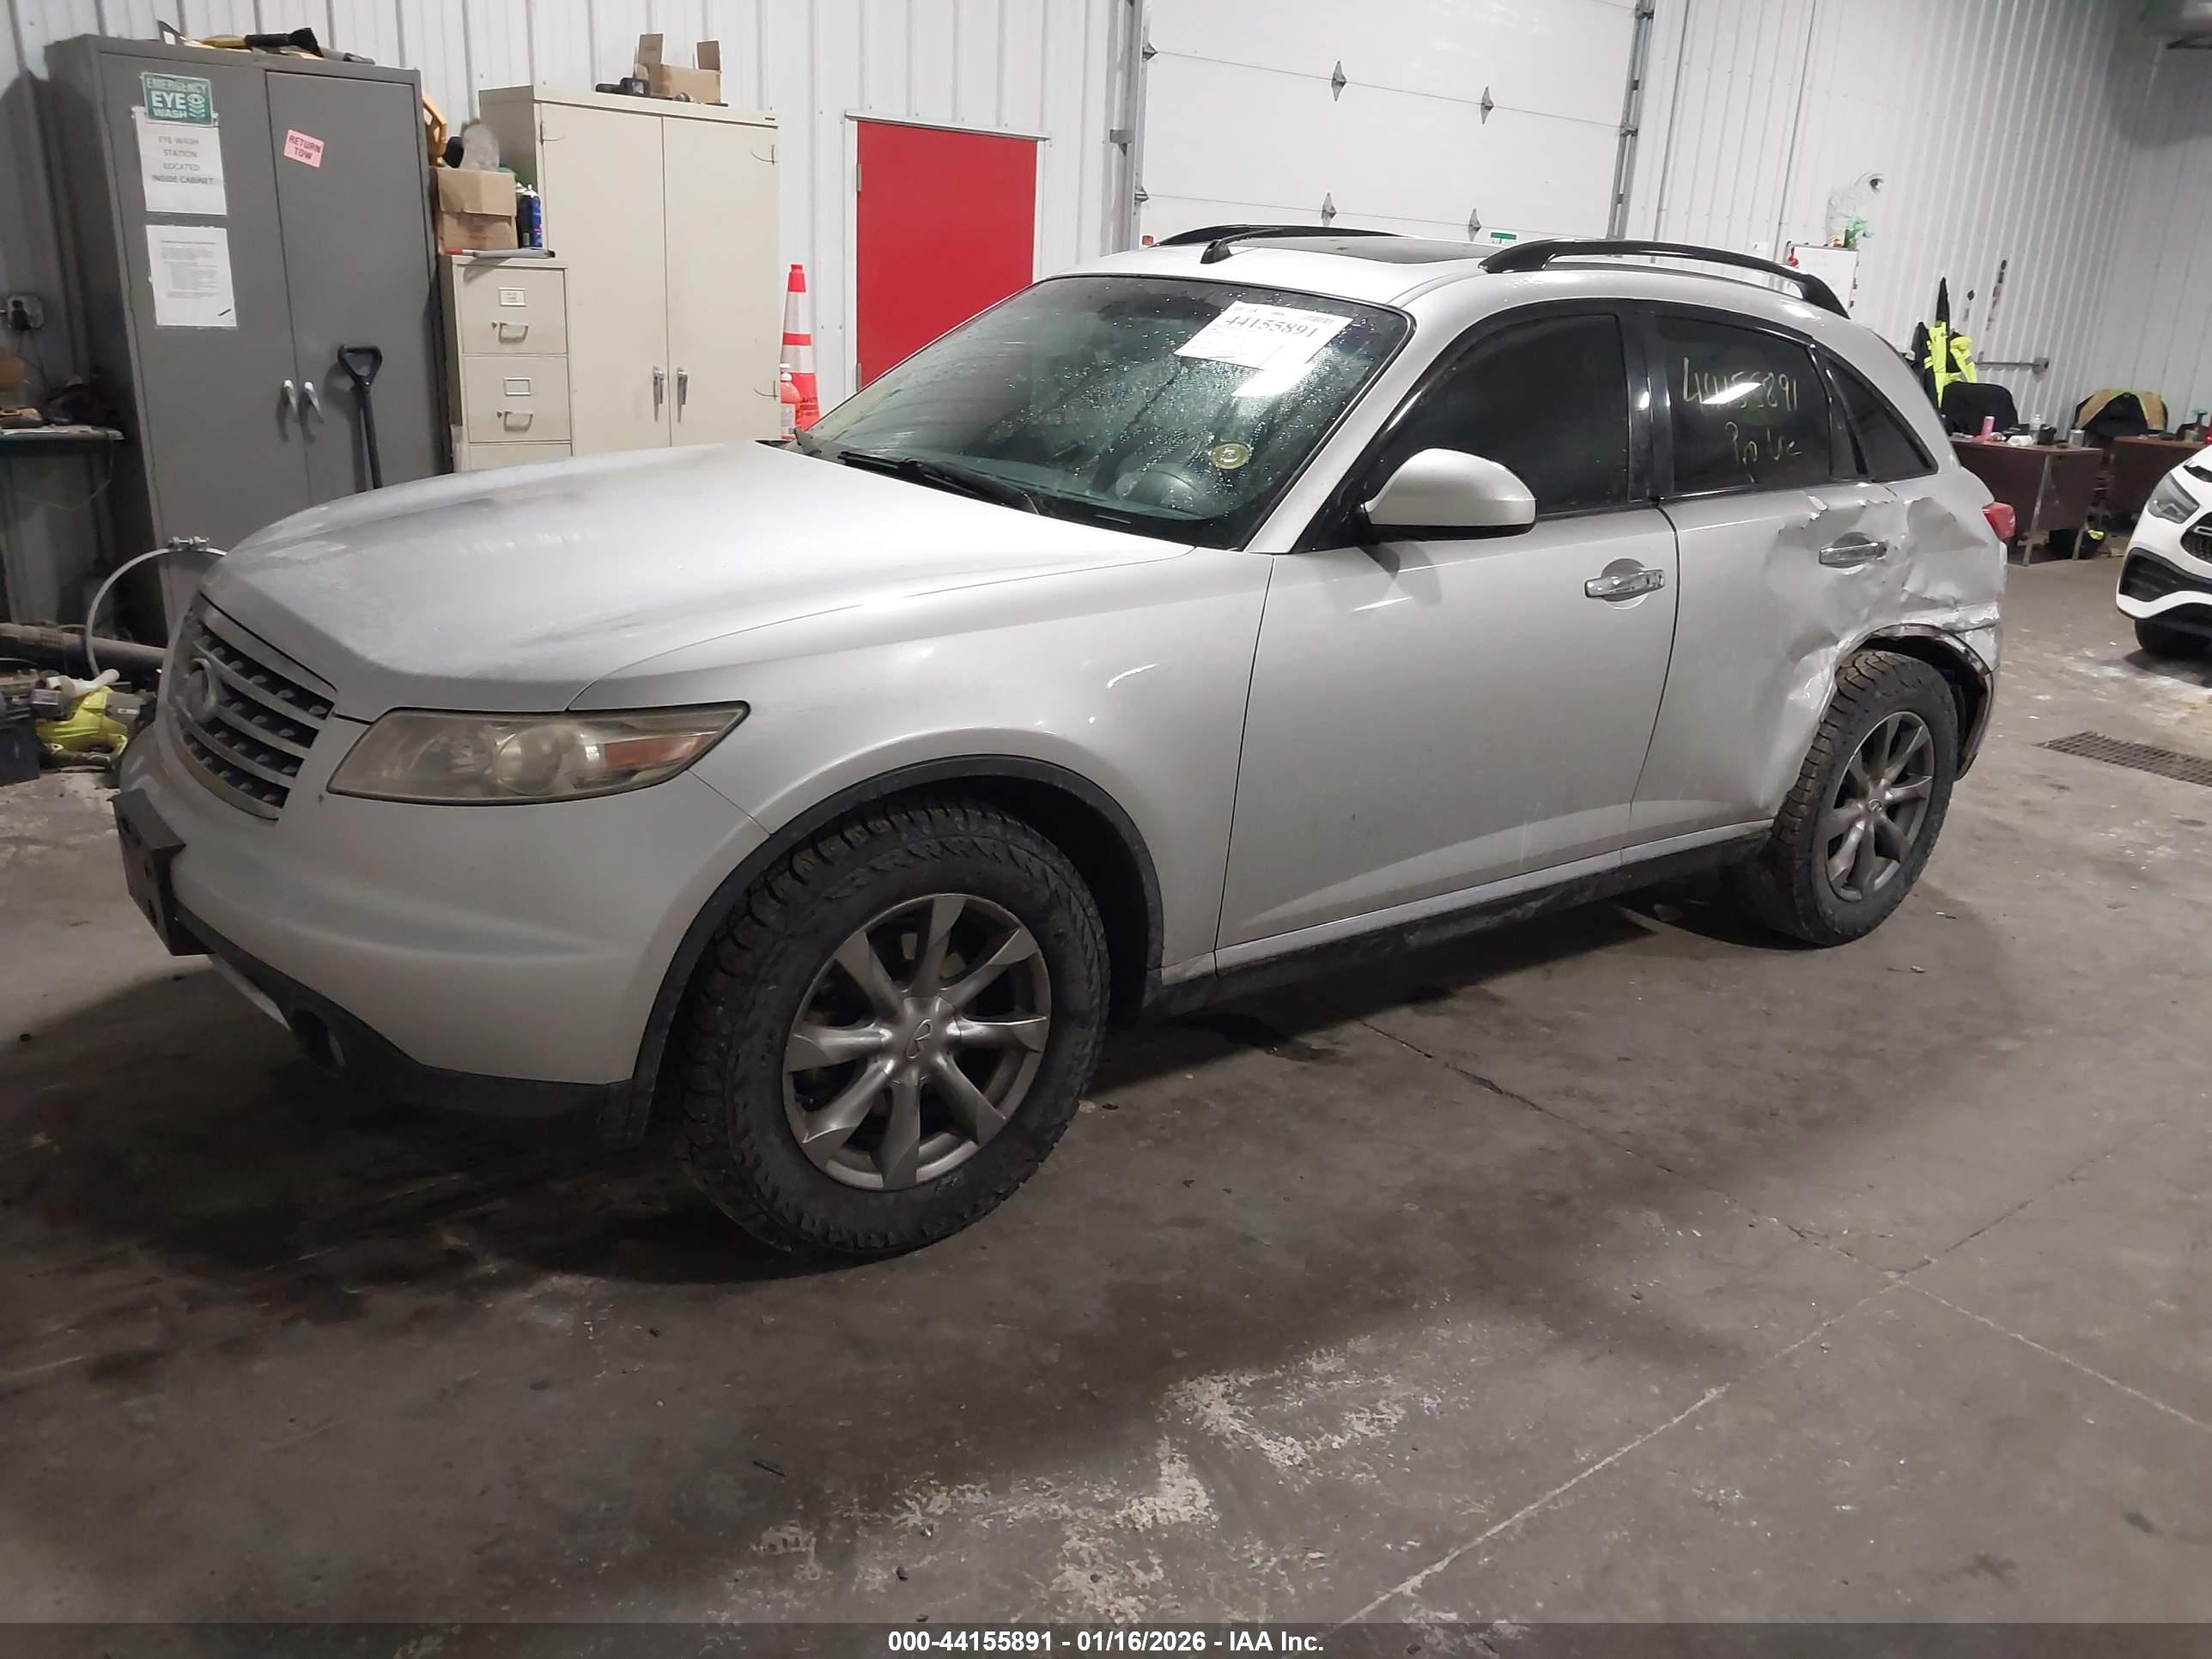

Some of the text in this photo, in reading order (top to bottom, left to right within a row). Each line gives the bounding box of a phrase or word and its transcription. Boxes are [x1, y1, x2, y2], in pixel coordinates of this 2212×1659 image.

[150, 90, 187, 110] EYE
[152, 107, 188, 118] WASH
[289, 135, 321, 153] RETURN
[295, 147, 313, 160] TOW
[163, 162, 200, 172] LOCATED
[179, 176, 213, 185] CABINET
[1224, 315, 1319, 337] 44155891
